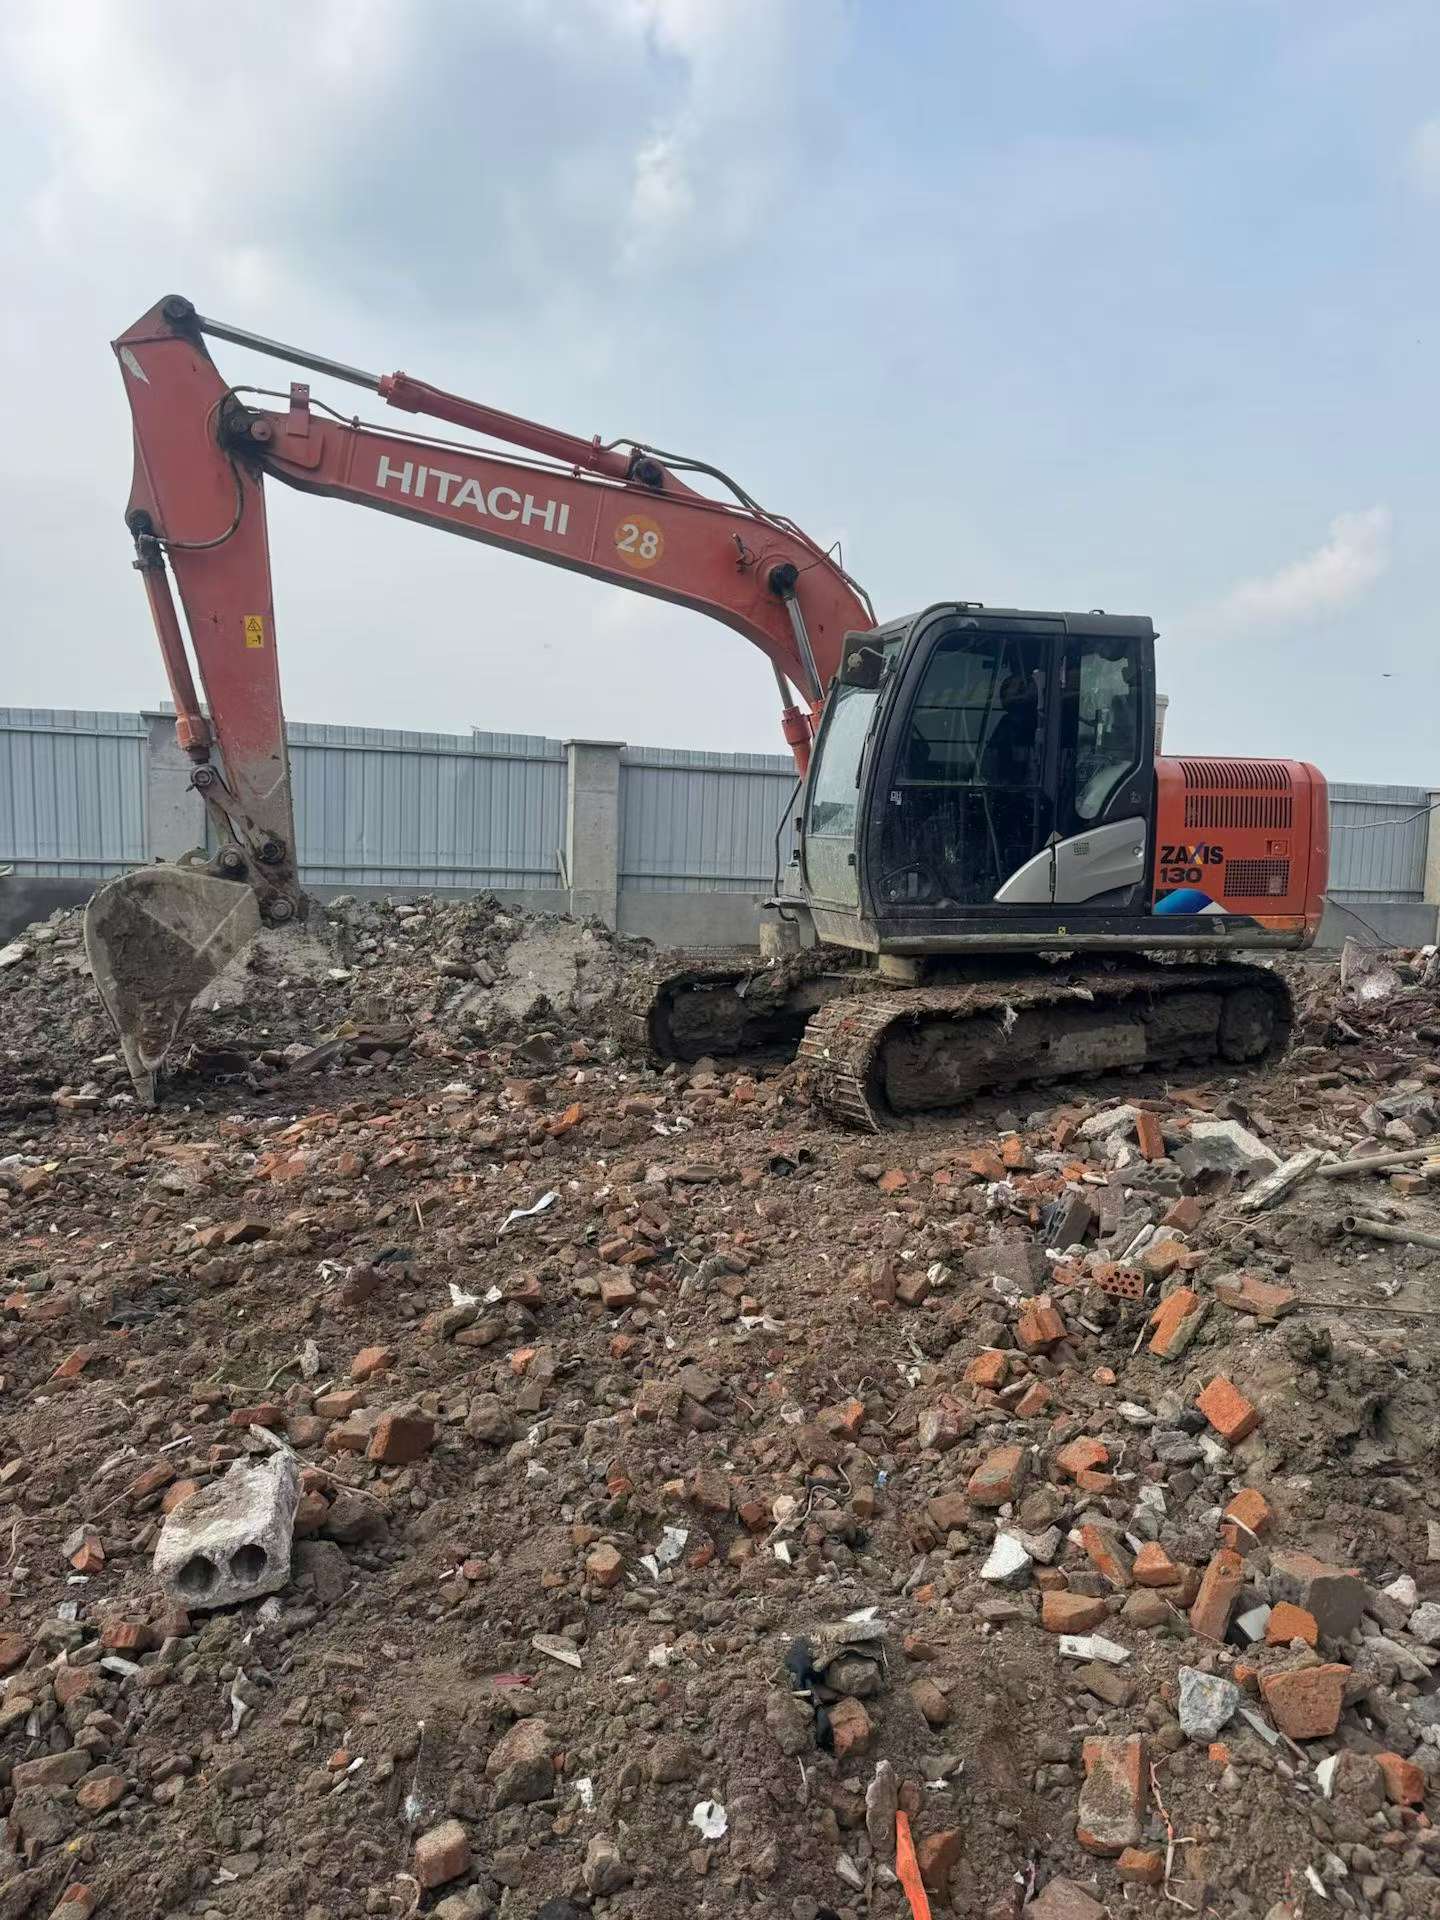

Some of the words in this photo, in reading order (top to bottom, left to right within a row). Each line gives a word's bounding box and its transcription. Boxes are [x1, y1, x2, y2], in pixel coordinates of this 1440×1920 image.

[376, 455, 570, 535] HITACHI
[616, 523, 658, 559] 28
[1160, 842, 1224, 865] ZAXIS
[1160, 867, 1202, 884] 130
